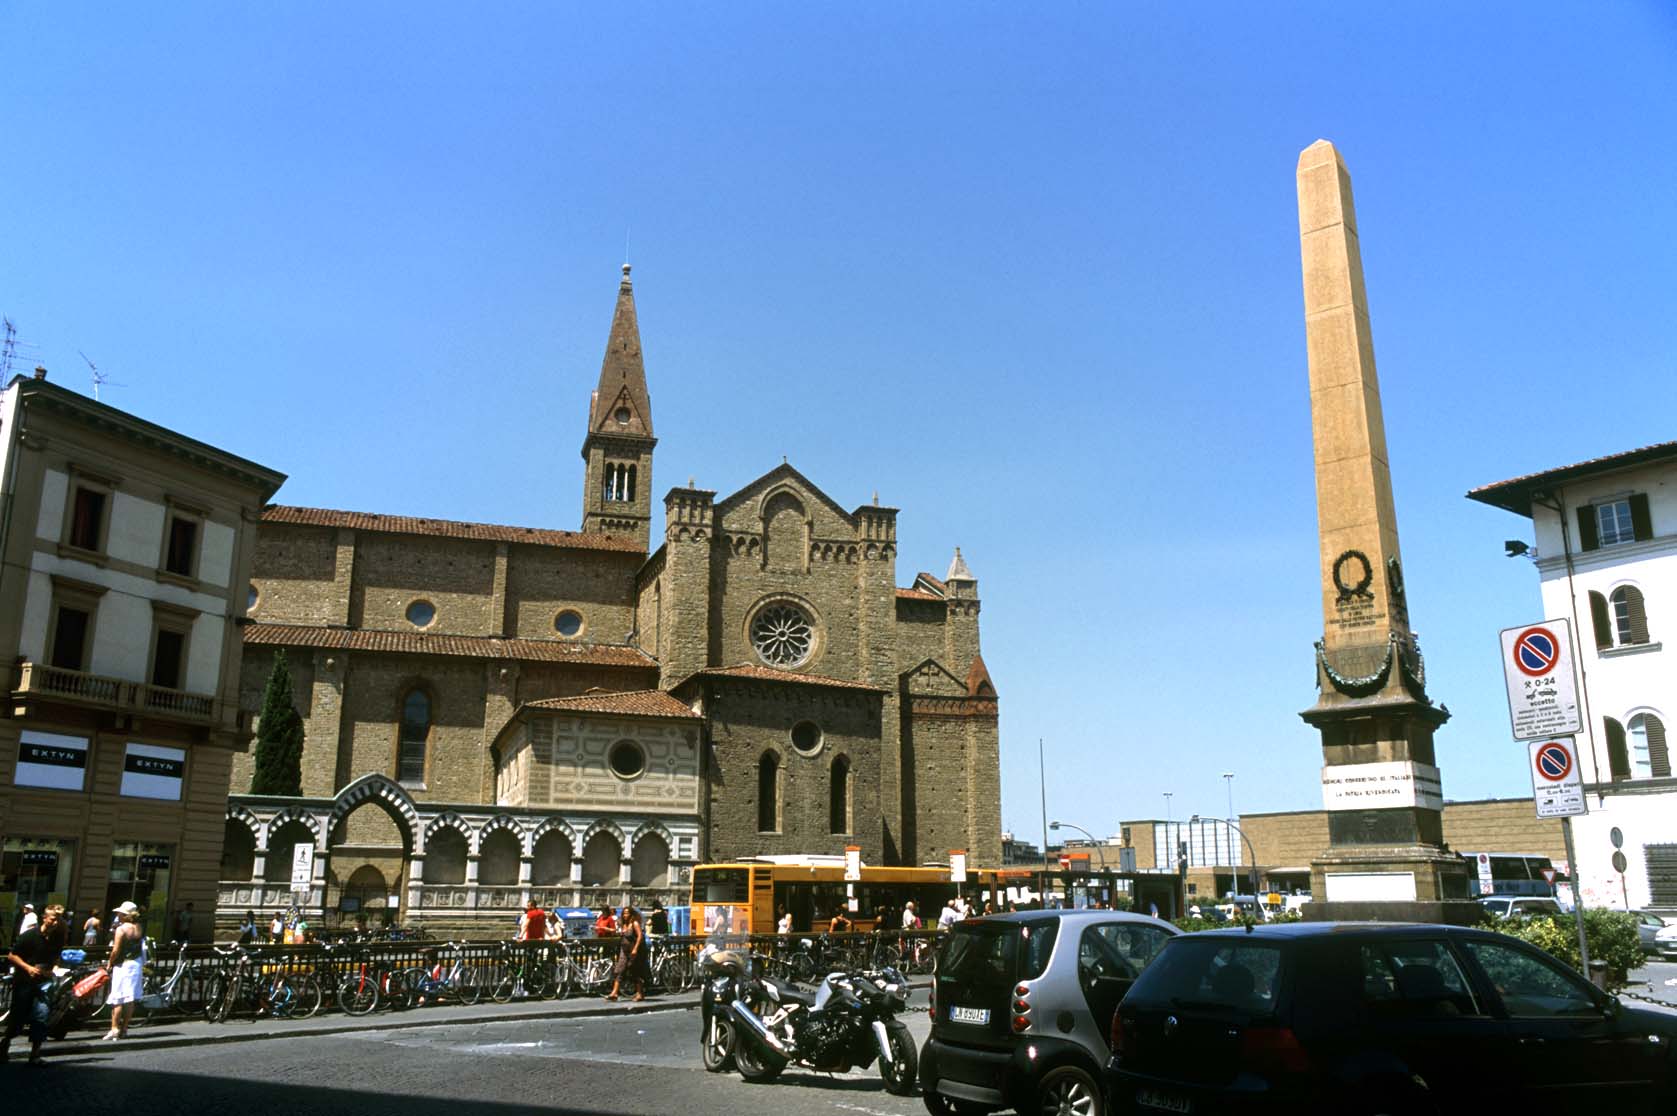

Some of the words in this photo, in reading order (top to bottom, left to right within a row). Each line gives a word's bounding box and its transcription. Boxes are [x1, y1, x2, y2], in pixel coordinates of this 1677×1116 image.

[1534, 677, 1556, 687] 0-24
[1530, 698, 1556, 707] eccetto
[31, 748, 75, 760] EXTYN
[136, 759, 175, 771] EXTYN
